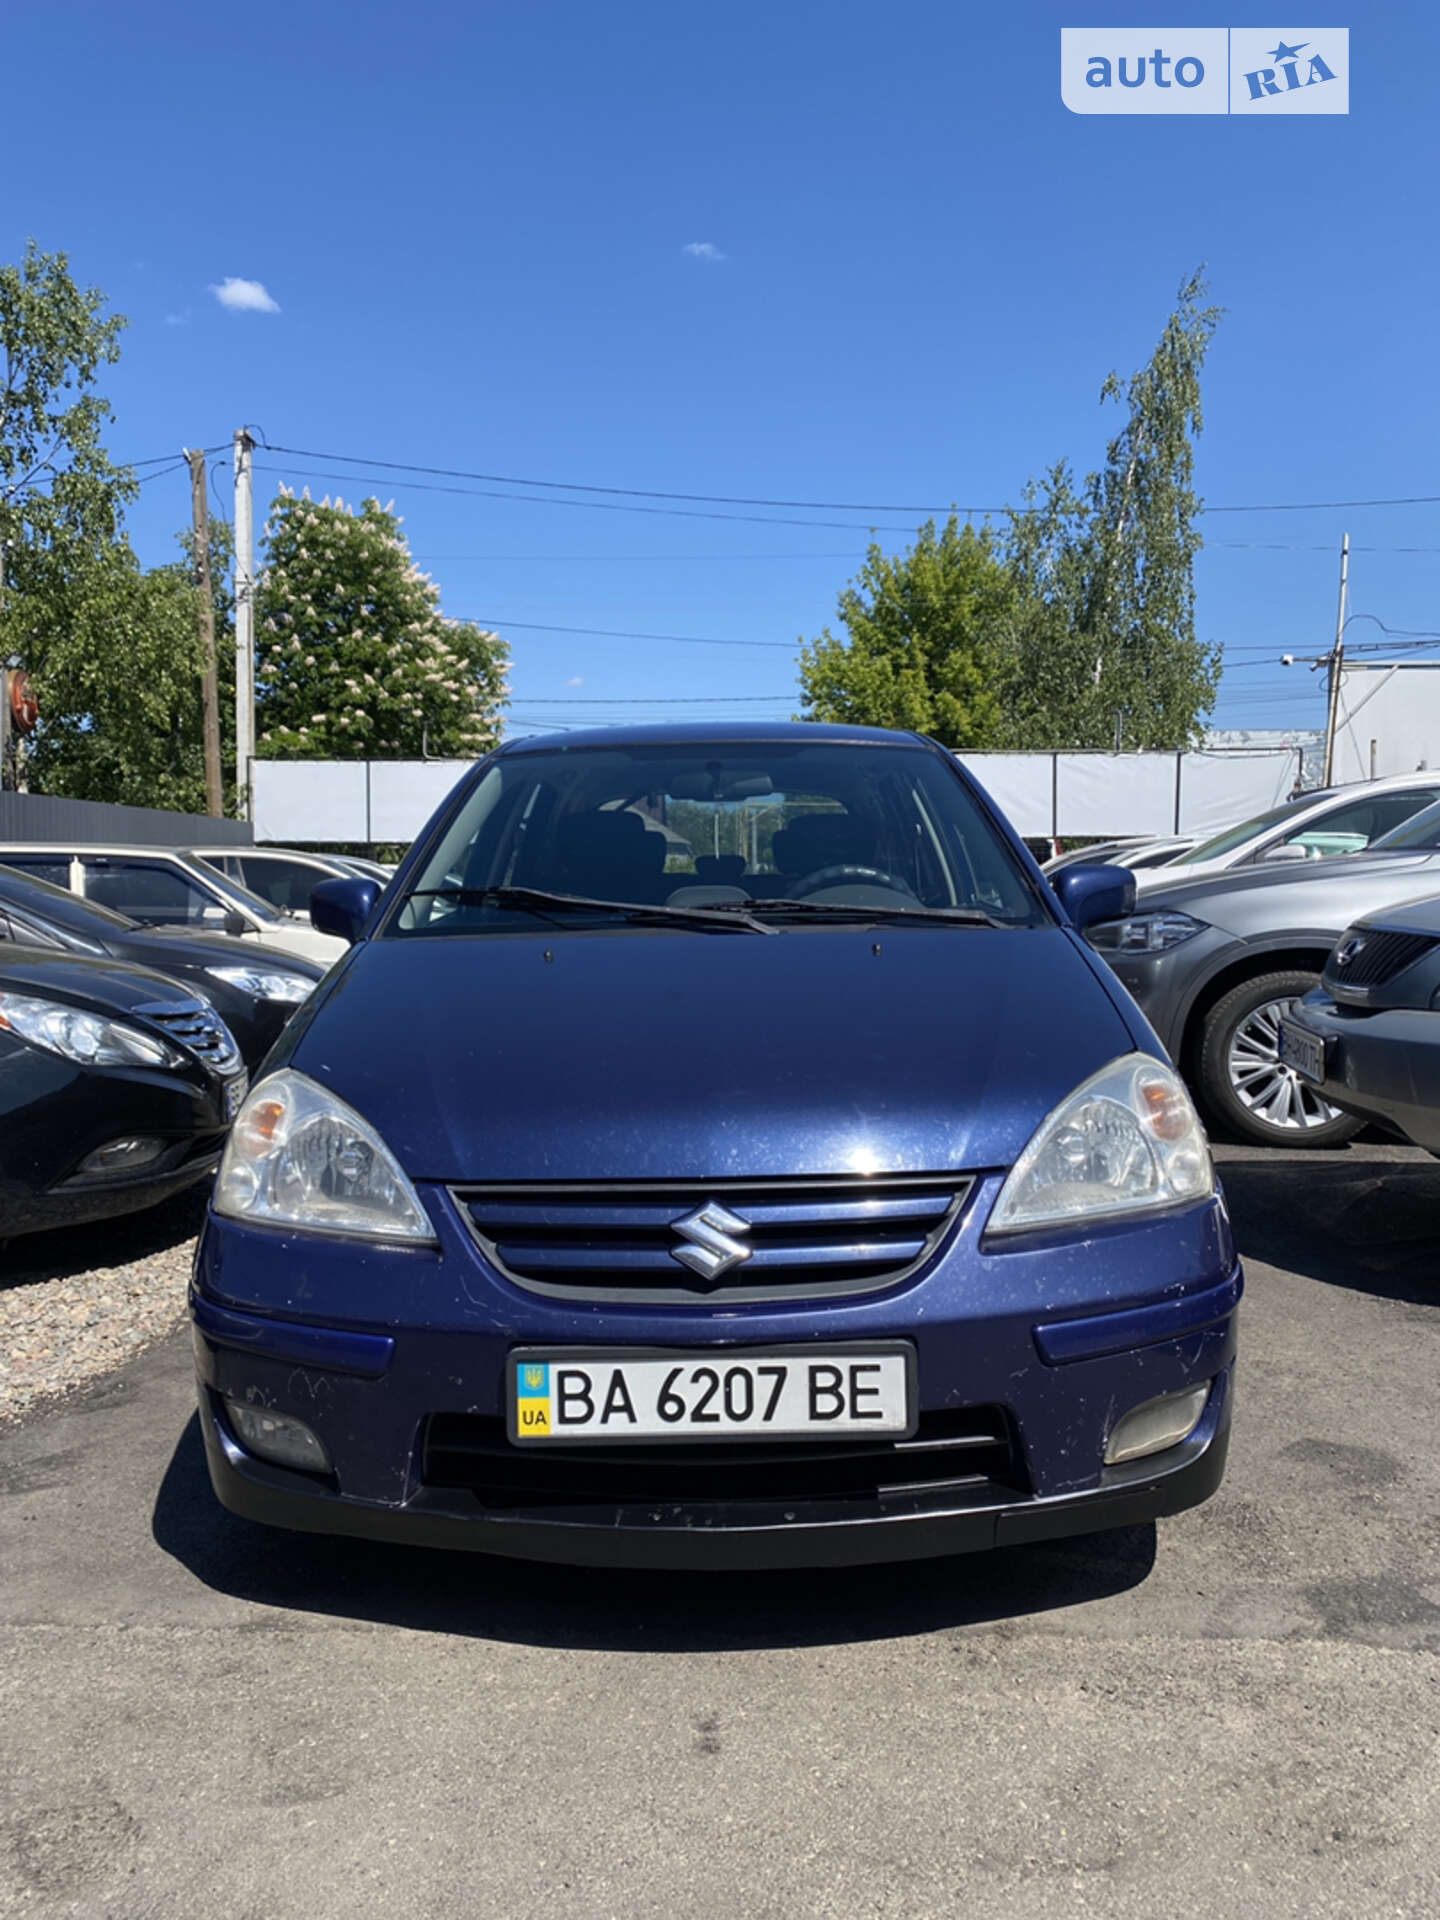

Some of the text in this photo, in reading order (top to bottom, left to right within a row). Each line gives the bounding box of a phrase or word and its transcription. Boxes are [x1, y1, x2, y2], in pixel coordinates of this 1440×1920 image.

[557, 1364, 883, 1425] BA 6207 BE
[522, 1410, 548, 1426] UA
